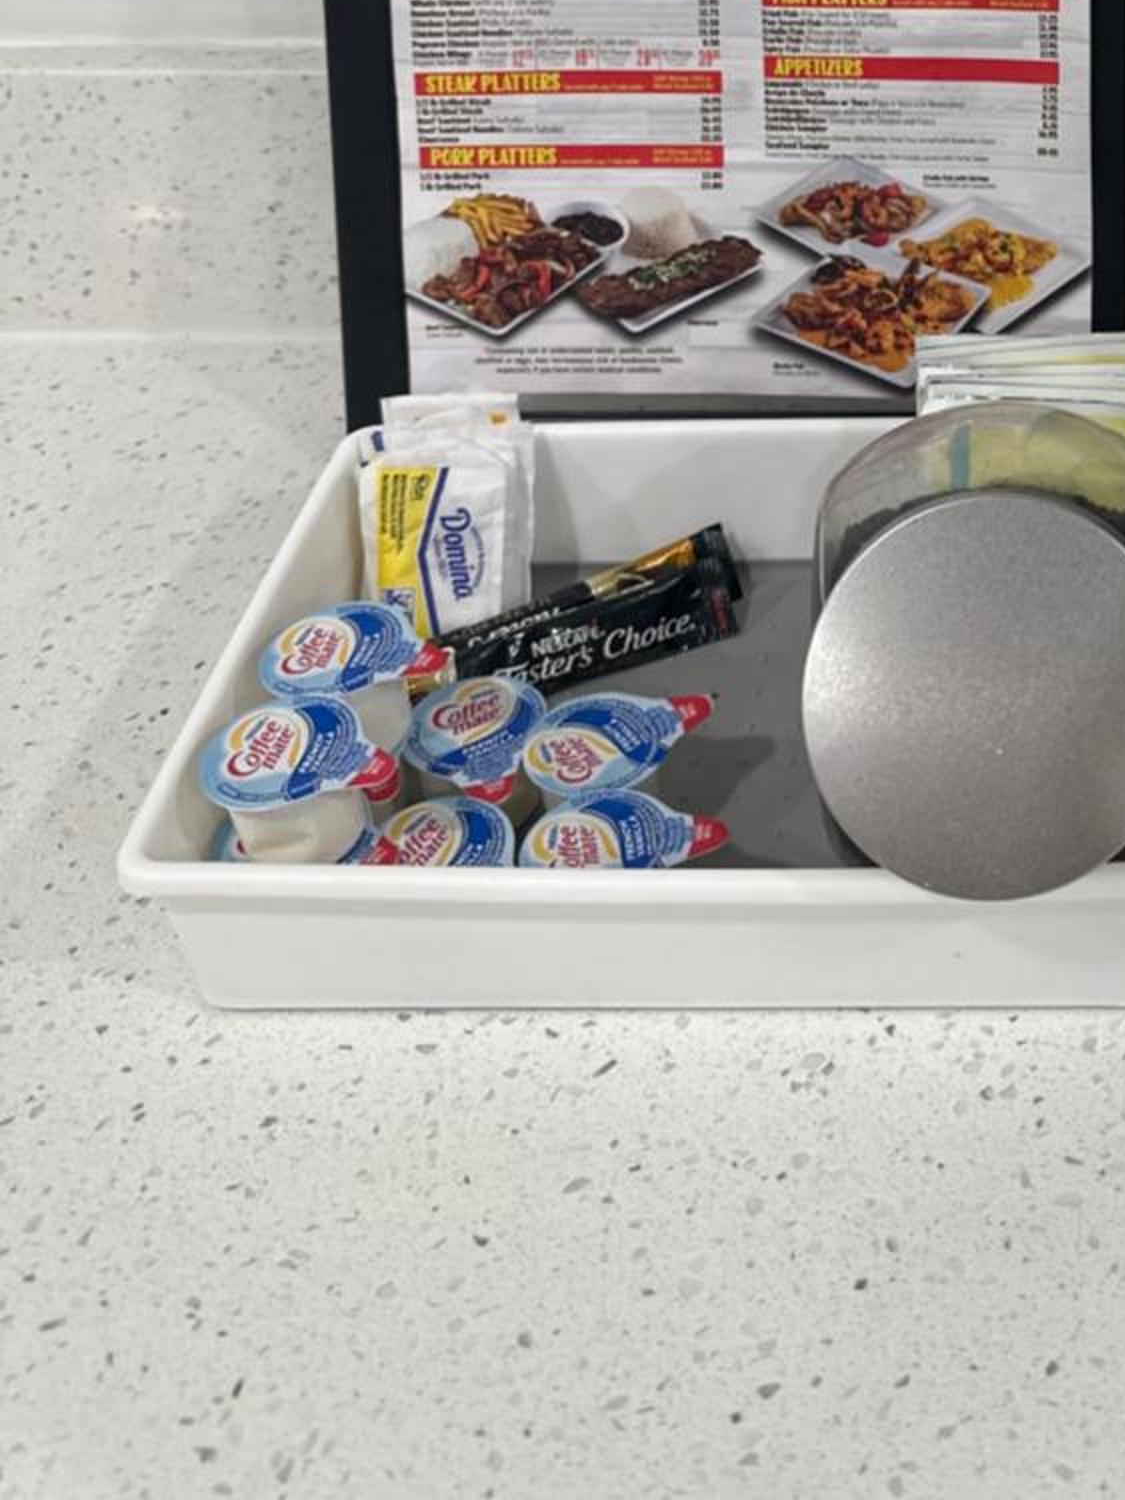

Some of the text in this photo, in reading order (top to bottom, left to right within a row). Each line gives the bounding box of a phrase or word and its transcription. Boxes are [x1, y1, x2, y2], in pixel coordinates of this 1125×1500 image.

[426, 73, 560, 93] STEAK PLATTERS
[774, 58, 864, 77] APPETIZERS
[431, 147, 557, 165] PORK PLATTERS
[440, 507, 474, 601] Domino
[282, 628, 329, 675] Coffee
[432, 694, 500, 729] Coffee
[228, 720, 281, 776] Coffee
[263, 724, 295, 769] mate
[401, 819, 440, 863] offee
[551, 825, 577, 867] offee
